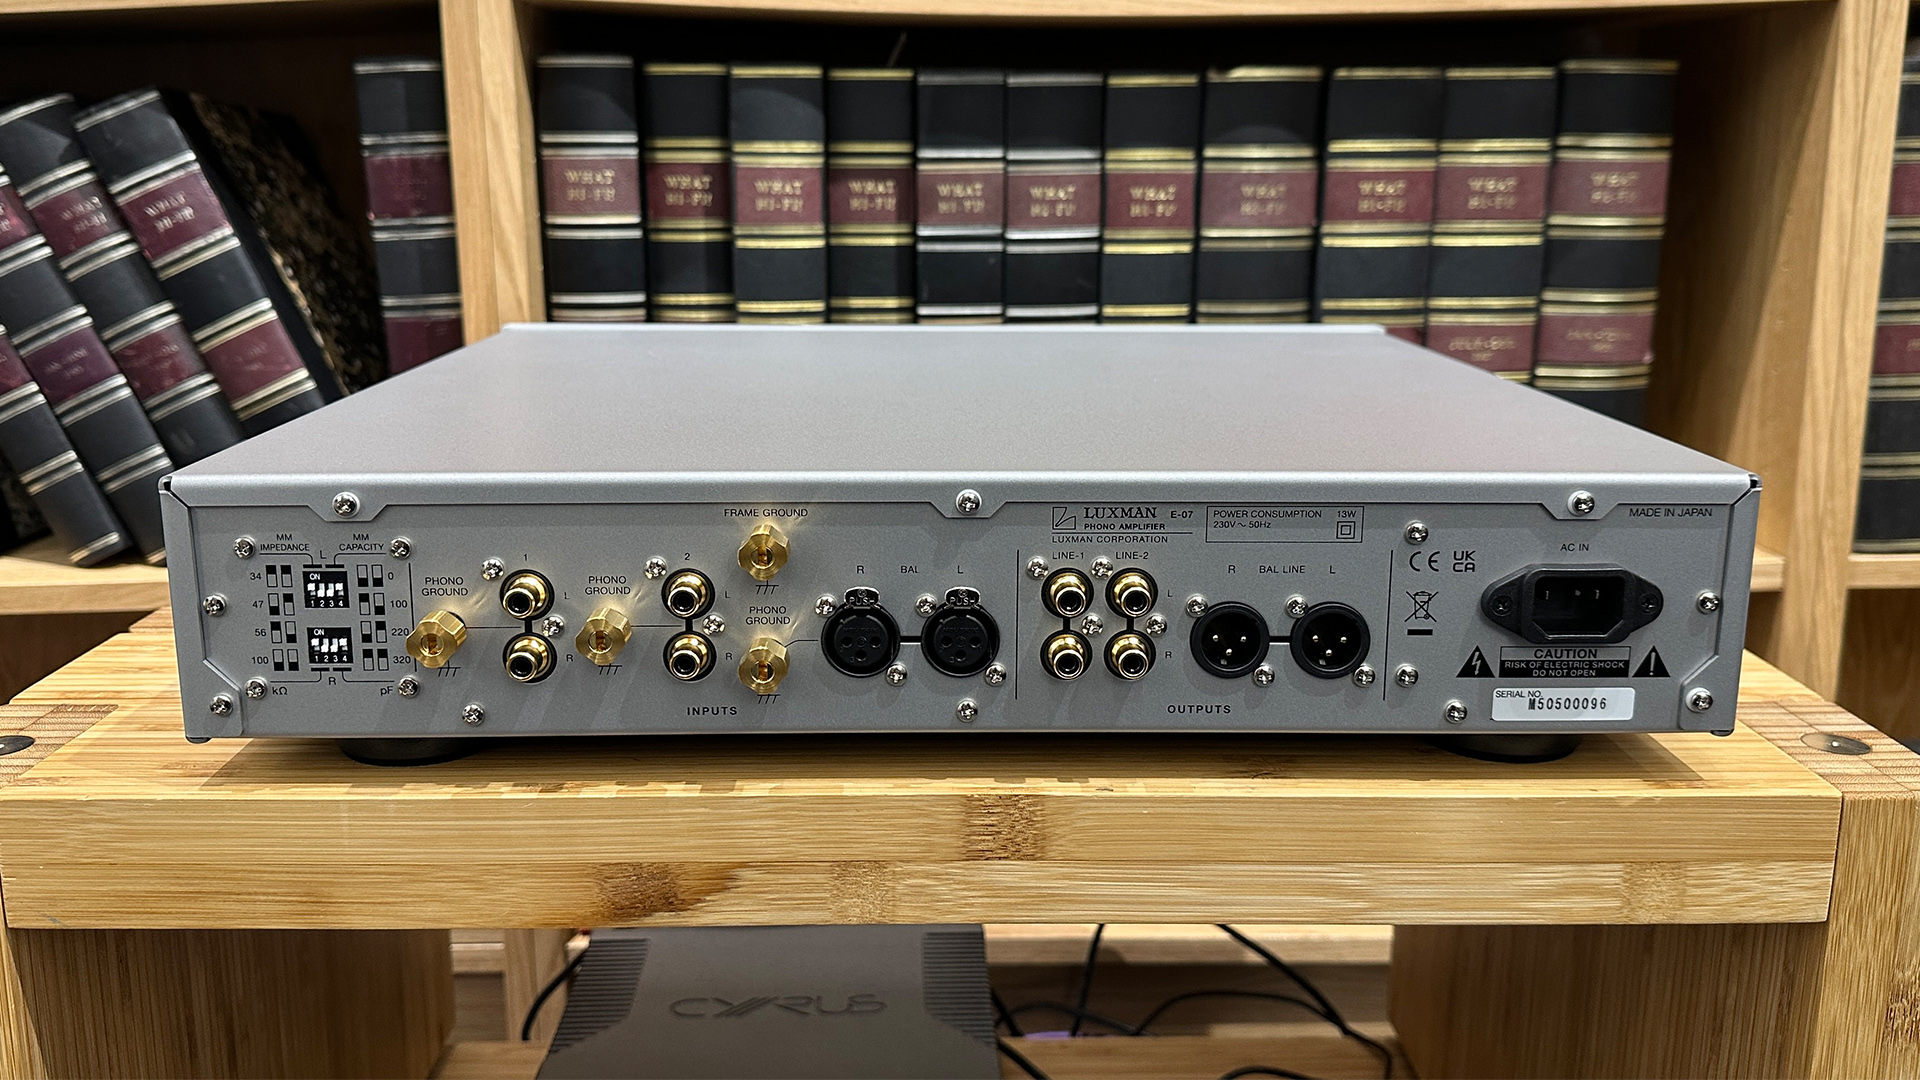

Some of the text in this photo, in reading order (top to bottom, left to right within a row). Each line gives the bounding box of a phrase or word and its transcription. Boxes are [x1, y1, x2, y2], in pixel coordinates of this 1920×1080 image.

[724, 508, 808, 517] FRAME GROUND
[1083, 507, 1157, 518] LUXMAN
[1170, 511, 1194, 519] E-07
[1213, 510, 1322, 518] POWER CONSUMPTION
[1629, 508, 1713, 517] MADE IN JAPAN
[1084, 523, 1166, 531] PHONO AMPLIFIER
[1213, 521, 1236, 529] 230V
[1248, 521, 1272, 529] 50Hz
[1052, 536, 1168, 544] LUXMAN CORPORATION
[260, 543, 310, 551] IMPEDANCE
[339, 543, 384, 551] CAPACITY
[1560, 543, 1590, 552] AC IN
[319, 550, 327, 560] L
[684, 553, 691, 561] 2
[1052, 552, 1084, 560] LINE-1
[1116, 552, 1149, 560] LINE-2
[1453, 550, 1476, 561] UK
[857, 565, 865, 574] R
[900, 565, 920, 574] BAL
[957, 565, 964, 574] L
[1228, 565, 1236, 574] R
[1259, 565, 1306, 574] BAL LINE
[1329, 565, 1336, 574] L
[1452, 562, 1476, 573] CA
[425, 577, 464, 585] PHONO
[588, 575, 627, 584] PHONO
[421, 587, 469, 596] GROUND
[585, 586, 631, 595] GROUND
[725, 591, 731, 599] L
[1167, 589, 1173, 598] L
[564, 592, 571, 600] L
[252, 600, 264, 608] 47
[390, 600, 408, 608] 100
[749, 605, 787, 614] PHONO
[745, 616, 791, 625] GROUND
[254, 629, 267, 637] 56
[391, 628, 410, 636] 220
[566, 654, 574, 662] R
[725, 652, 733, 661] R
[1165, 651, 1172, 659] R
[1533, 648, 1598, 659] CAUTION
[251, 656, 269, 664] 100
[393, 656, 411, 664] 320
[328, 677, 336, 685] R
[380, 686, 394, 696] pF
[1495, 690, 1543, 698] SERIAL NO.
[1528, 698, 1607, 710] M50500096
[686, 706, 738, 716] INPUTS
[1167, 704, 1232, 714] OUTPUTS
[669, 993, 888, 1019] CYRUS
